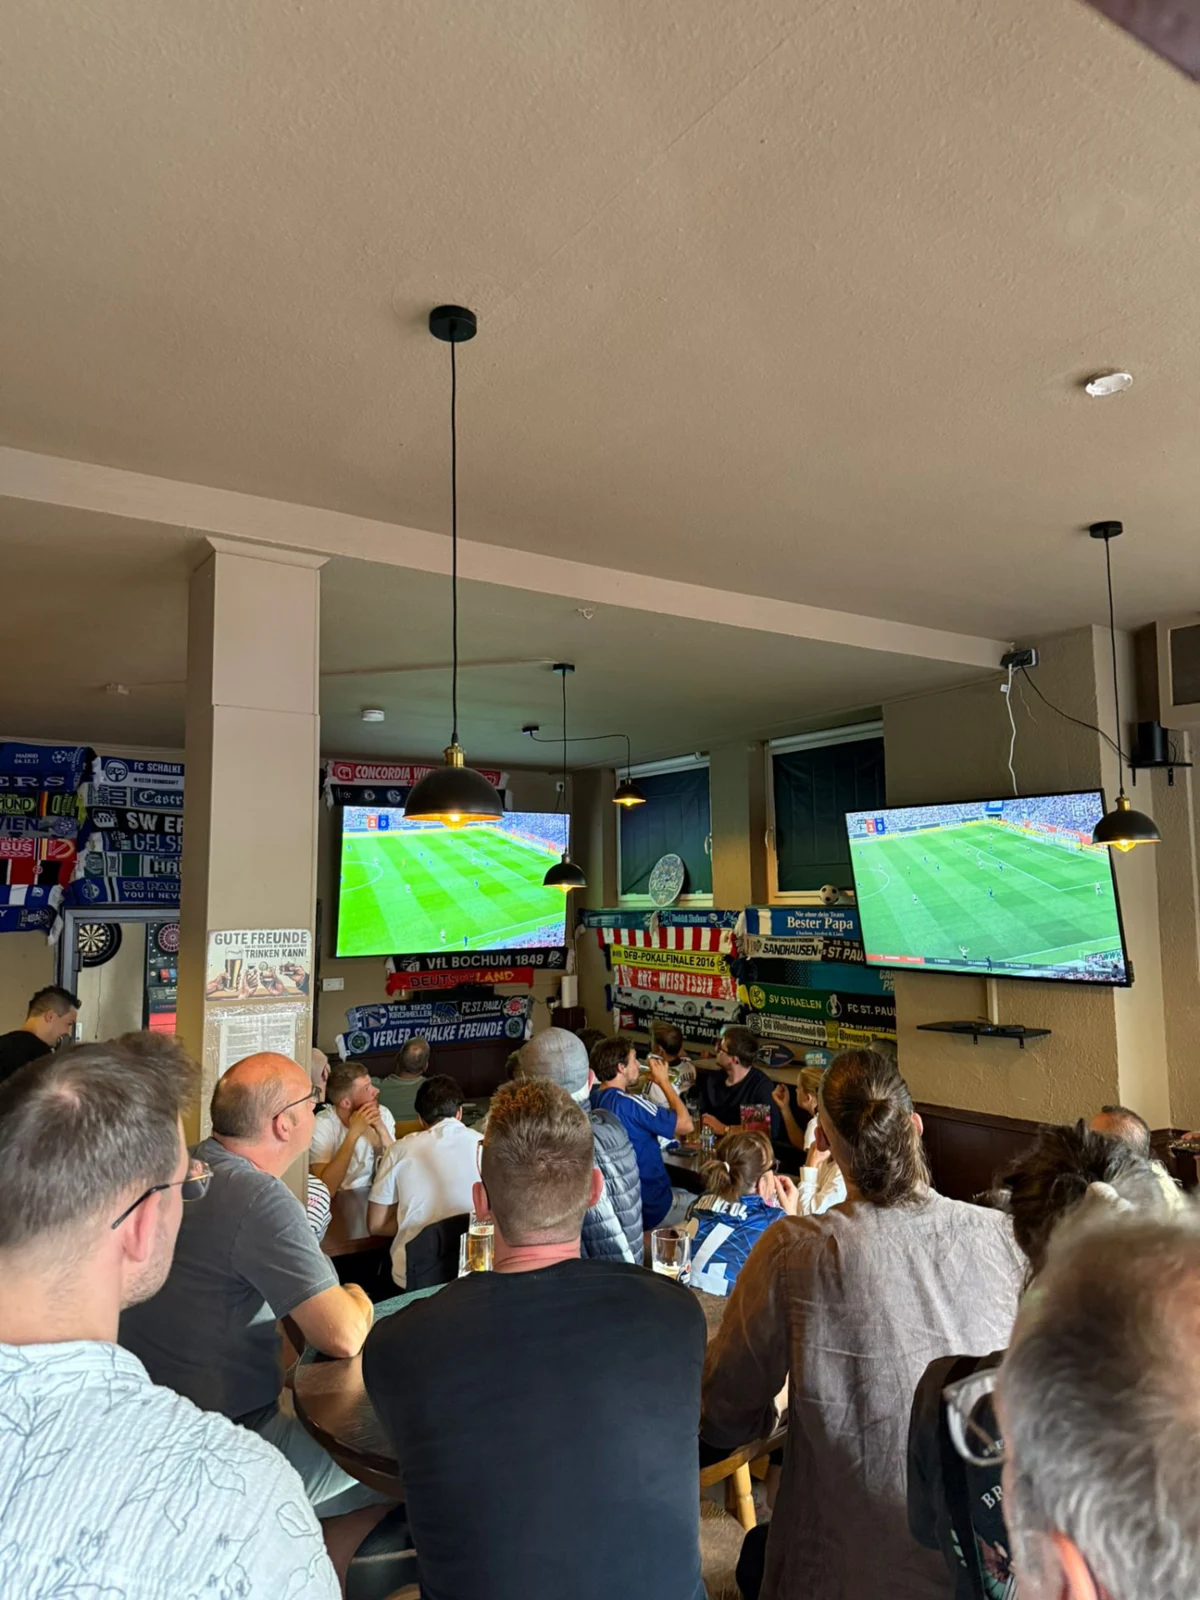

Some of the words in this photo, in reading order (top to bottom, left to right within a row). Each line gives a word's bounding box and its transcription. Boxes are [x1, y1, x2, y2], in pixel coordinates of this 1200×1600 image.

[133, 762, 144, 771] FC
[147, 763, 182, 774] SCHALKE
[355, 765, 411, 780] CONCORDIA
[126, 811, 159, 831] SW
[787, 916, 822, 929] Bester
[824, 918, 854, 932] Papa
[214, 932, 248, 945] GUTE
[250, 931, 307, 944] FREUNDE
[244, 949, 280, 959] TRINKEN
[281, 948, 307, 958] KANN!
[623, 950, 695, 967] DFB-POKALFINALE
[696, 957, 716, 968] 2016
[762, 943, 818, 957] SANDHAUSEN
[843, 949, 864, 962] PAU
[426, 957, 448, 970] VfL
[450, 954, 512, 969] BOCHUM
[514, 953, 544, 966] 1848
[659, 970, 687, 992] WEISS
[410, 1003, 433, 1011] 1920
[460, 1001, 471, 1013] FC
[768, 994, 780, 1004] SV
[780, 996, 822, 1009] STRAELEN
[847, 1004, 859, 1012] FC
[372, 1026, 412, 1049] VERLER
[414, 1025, 456, 1042] SCHALKE
[459, 1021, 503, 1040] FREUNDE
